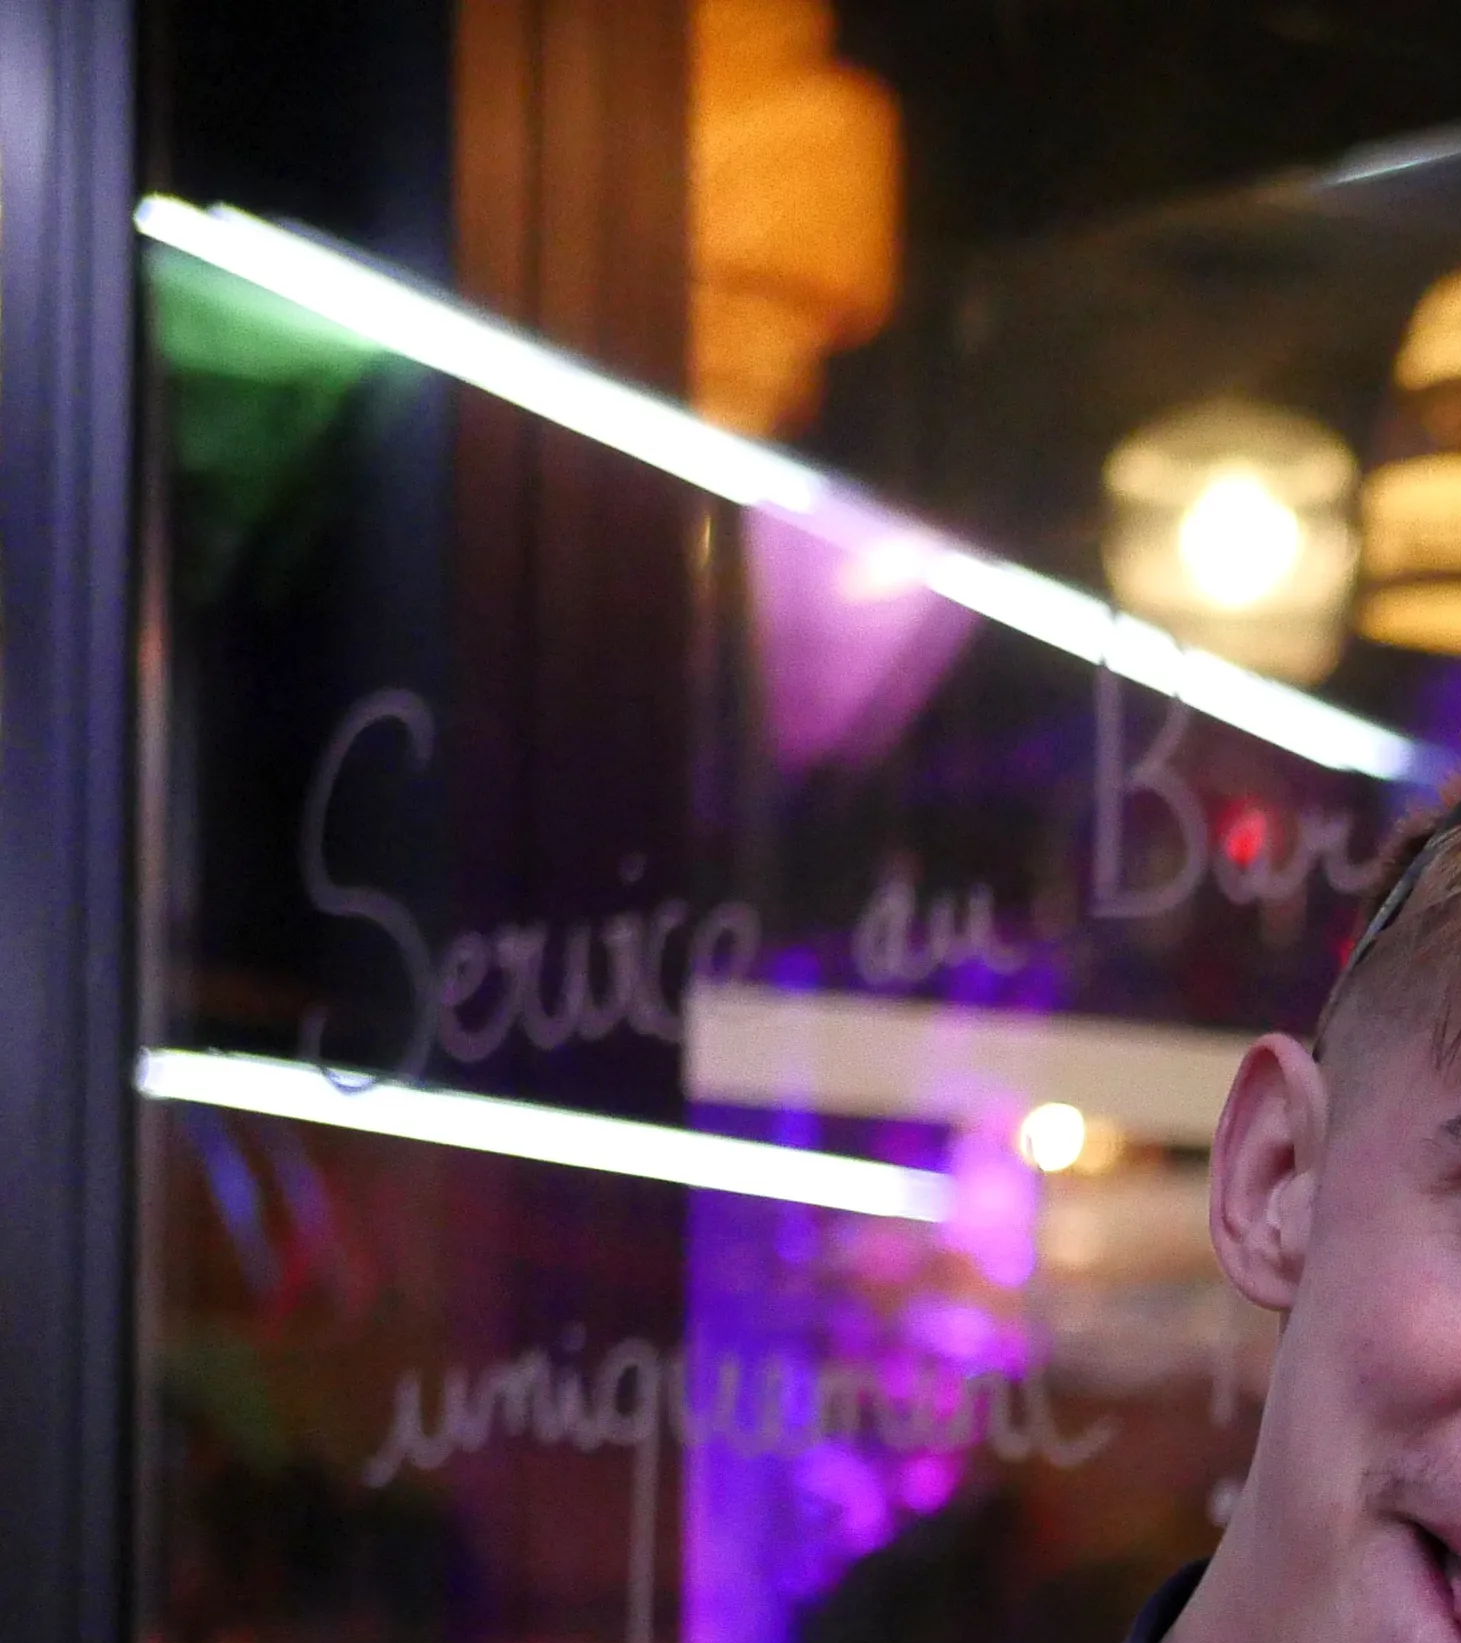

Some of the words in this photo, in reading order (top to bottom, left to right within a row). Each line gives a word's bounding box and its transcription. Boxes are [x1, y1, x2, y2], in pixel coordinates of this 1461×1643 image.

[302, 686, 766, 1096] Service
[852, 858, 1028, 986] du
[1090, 595, 1396, 920] Bar
